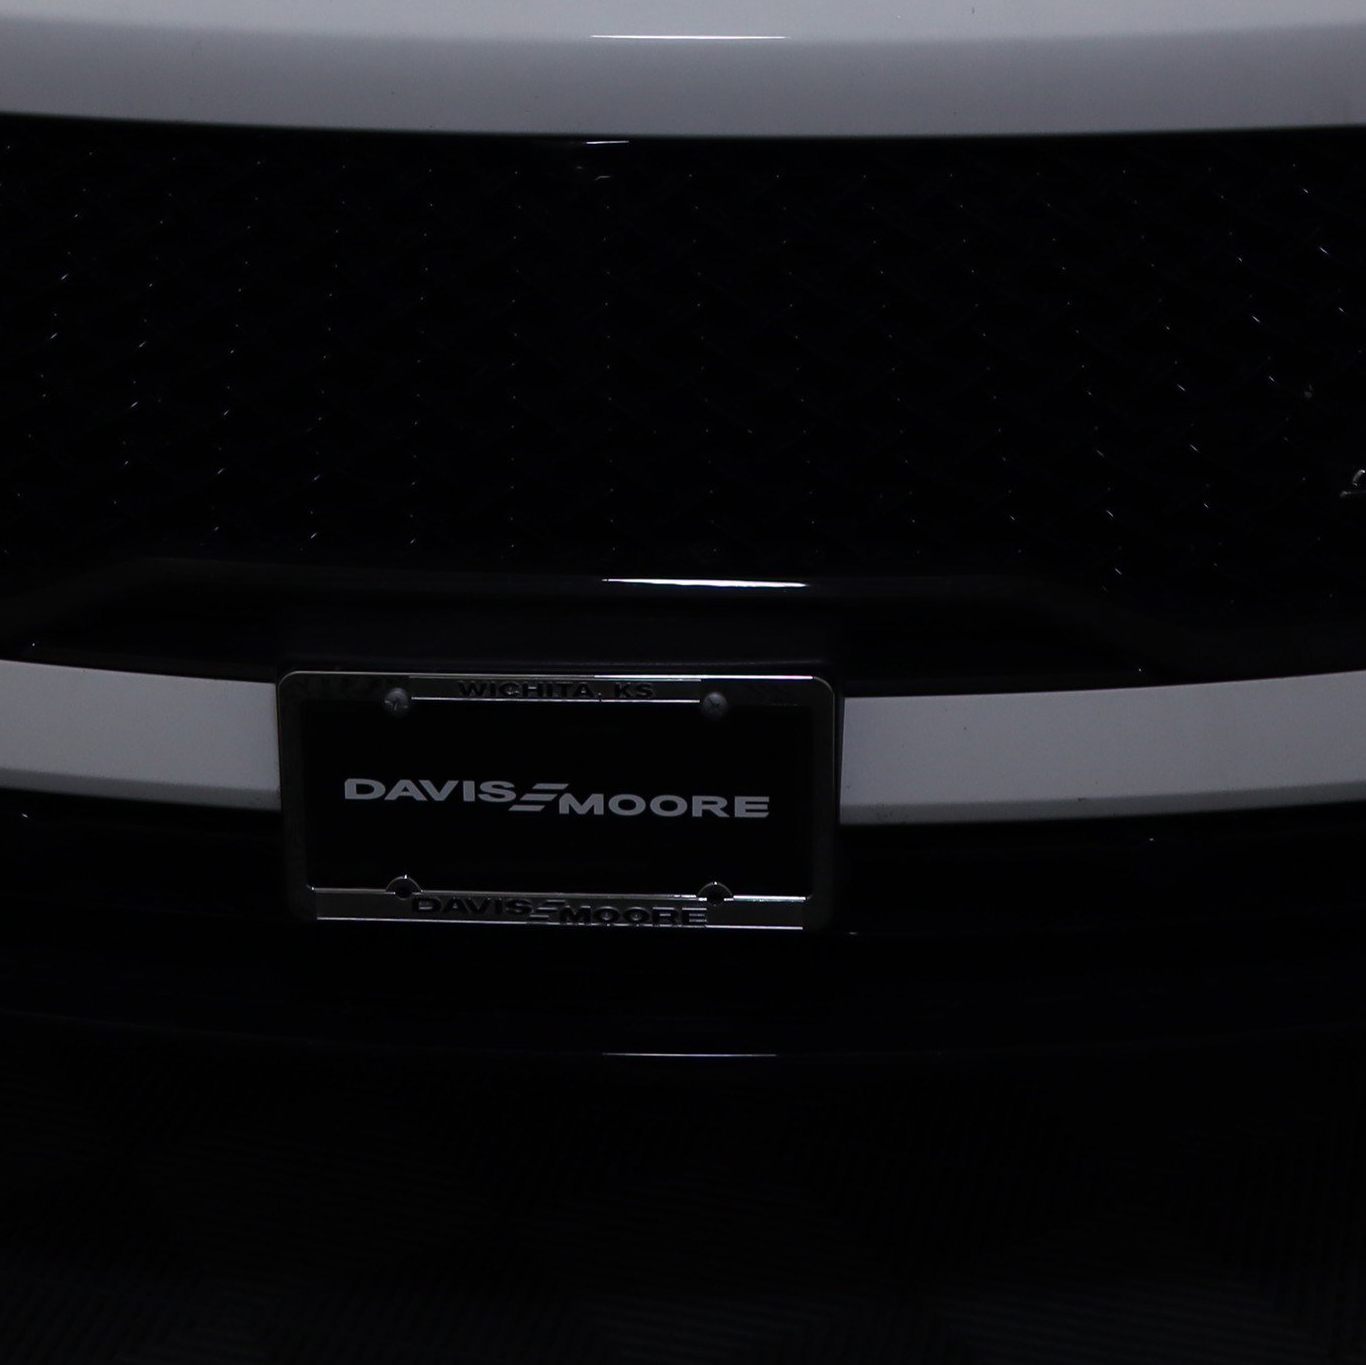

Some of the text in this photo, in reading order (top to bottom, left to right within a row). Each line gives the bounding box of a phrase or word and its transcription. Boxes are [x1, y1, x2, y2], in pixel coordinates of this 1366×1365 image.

[615, 681, 654, 698] KS
[344, 778, 770, 819] DAVIS MOORE
[412, 897, 708, 926] DAVIS MOORE
